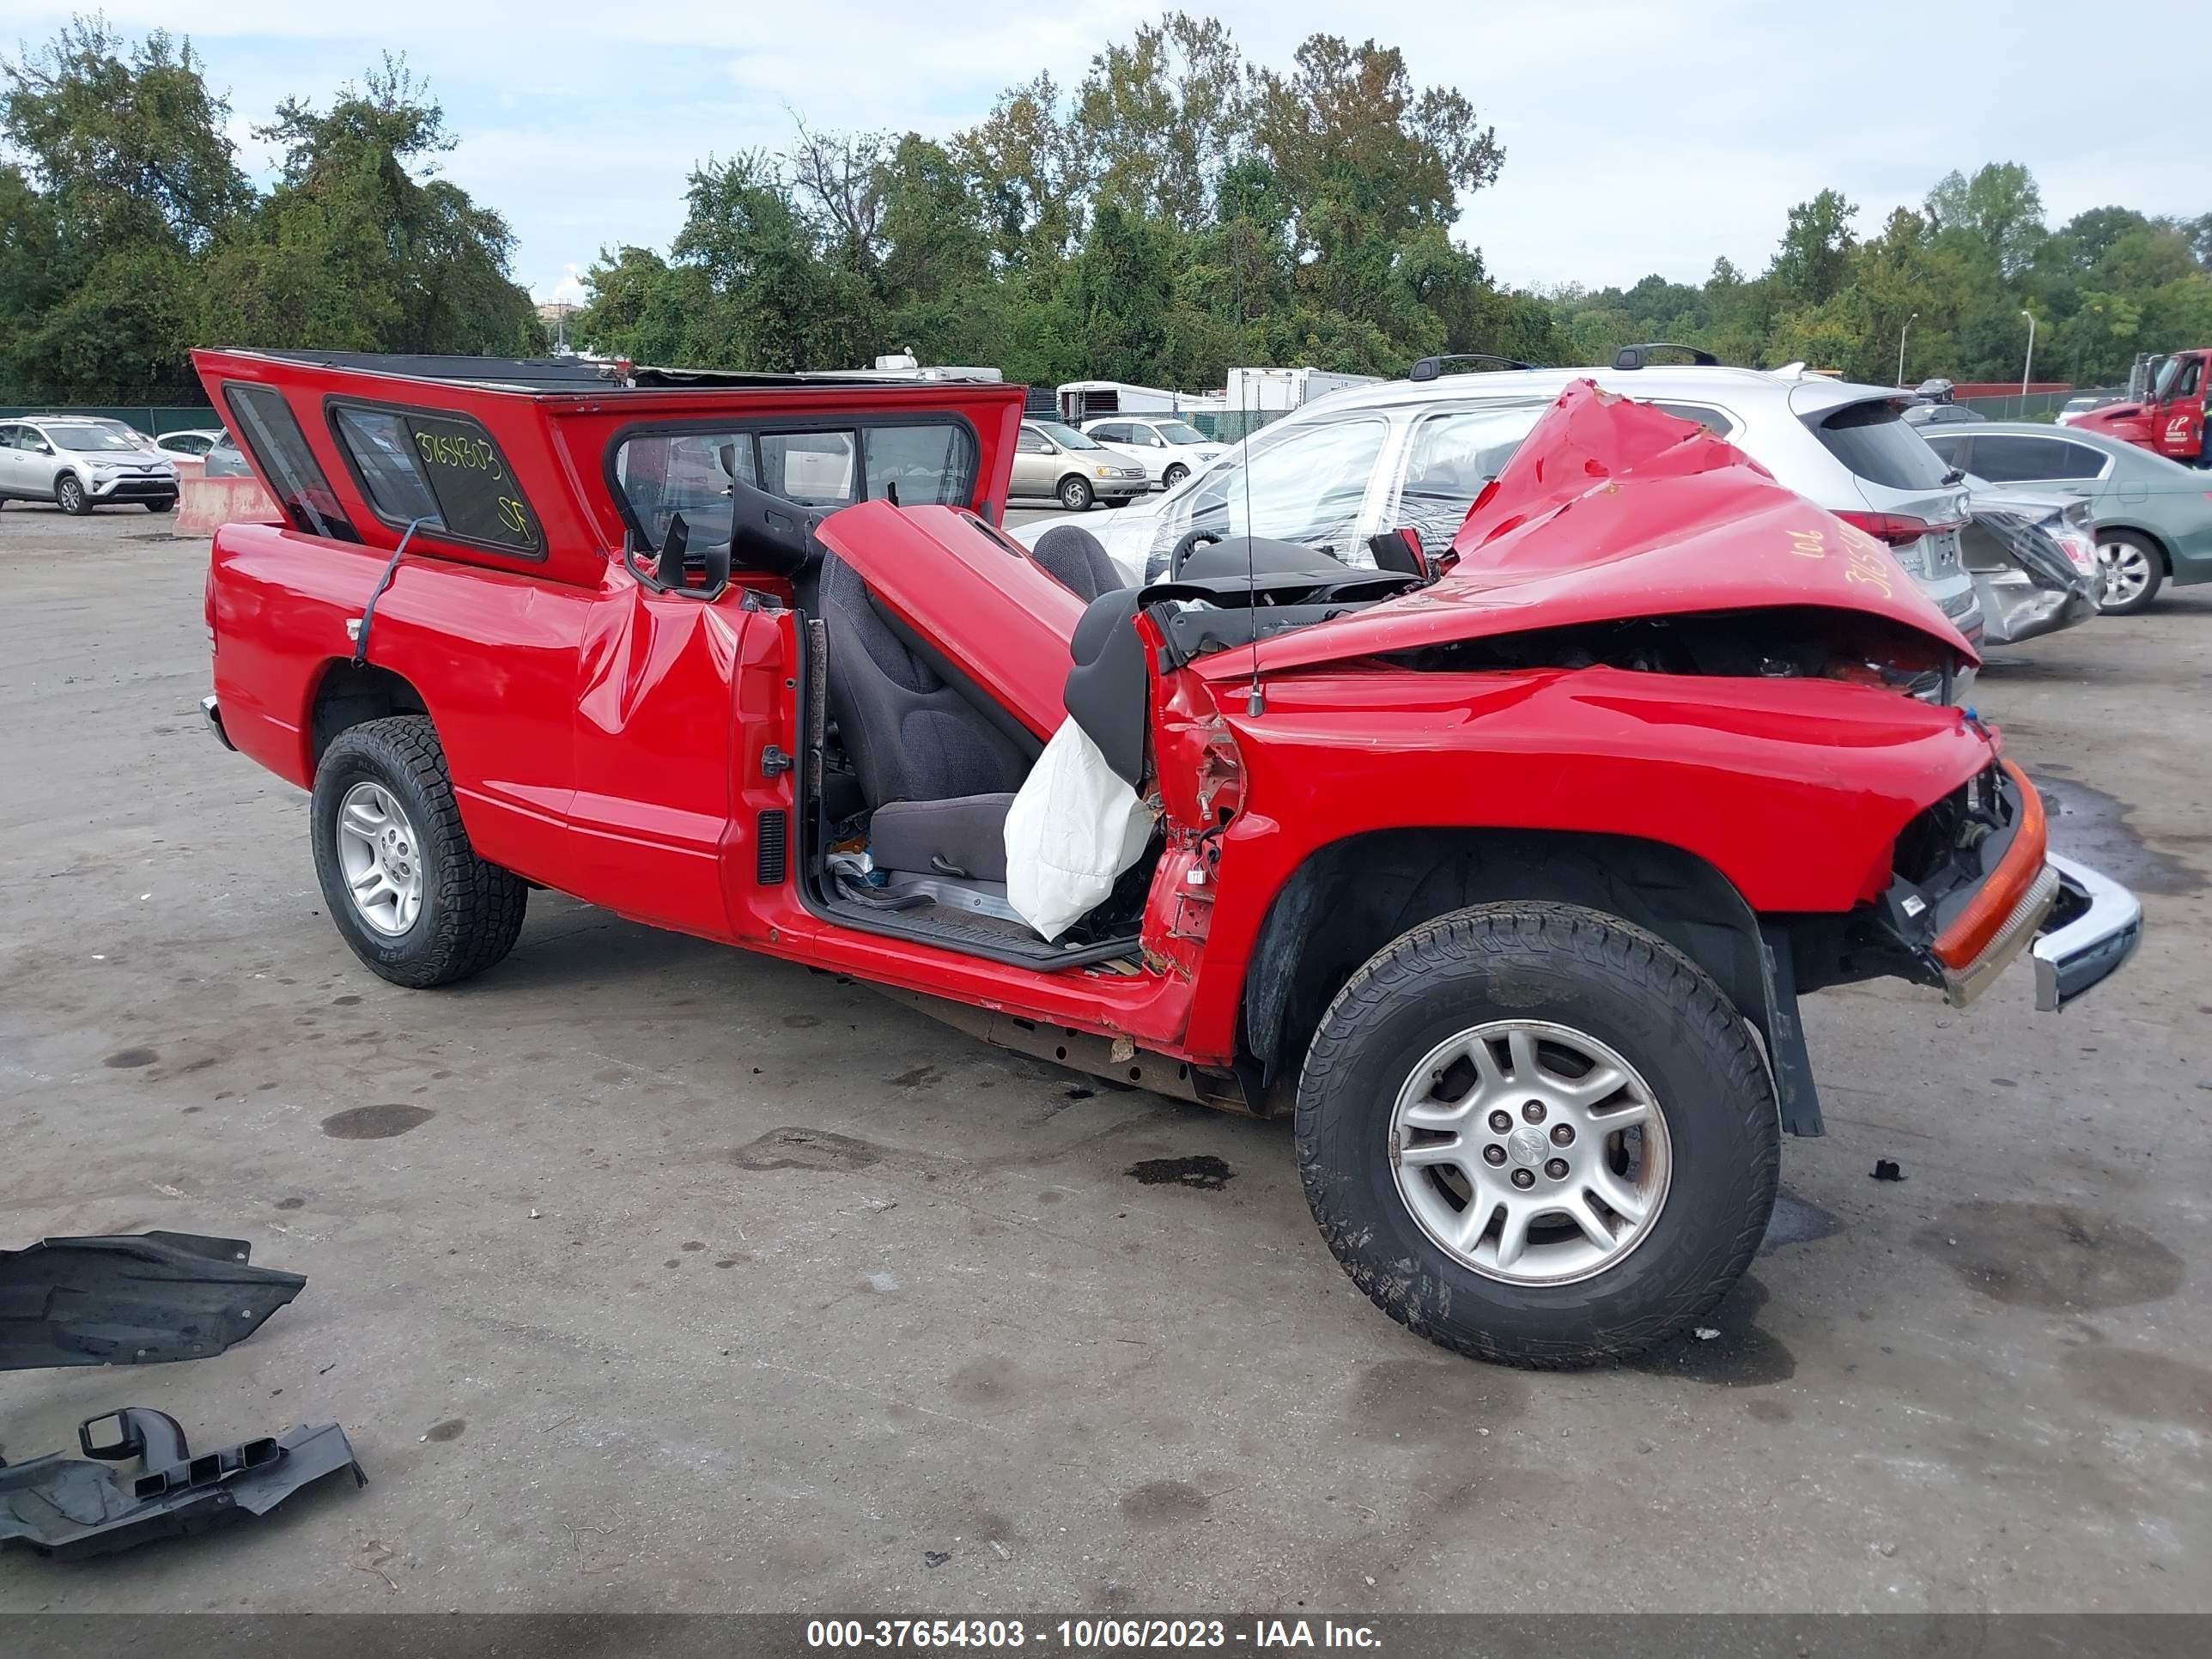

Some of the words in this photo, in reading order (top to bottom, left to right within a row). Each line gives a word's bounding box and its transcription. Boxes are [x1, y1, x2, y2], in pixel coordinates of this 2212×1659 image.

[2166, 416, 2190, 431] LP
[415, 432, 502, 480] 37654303
[497, 496, 532, 541] SF
